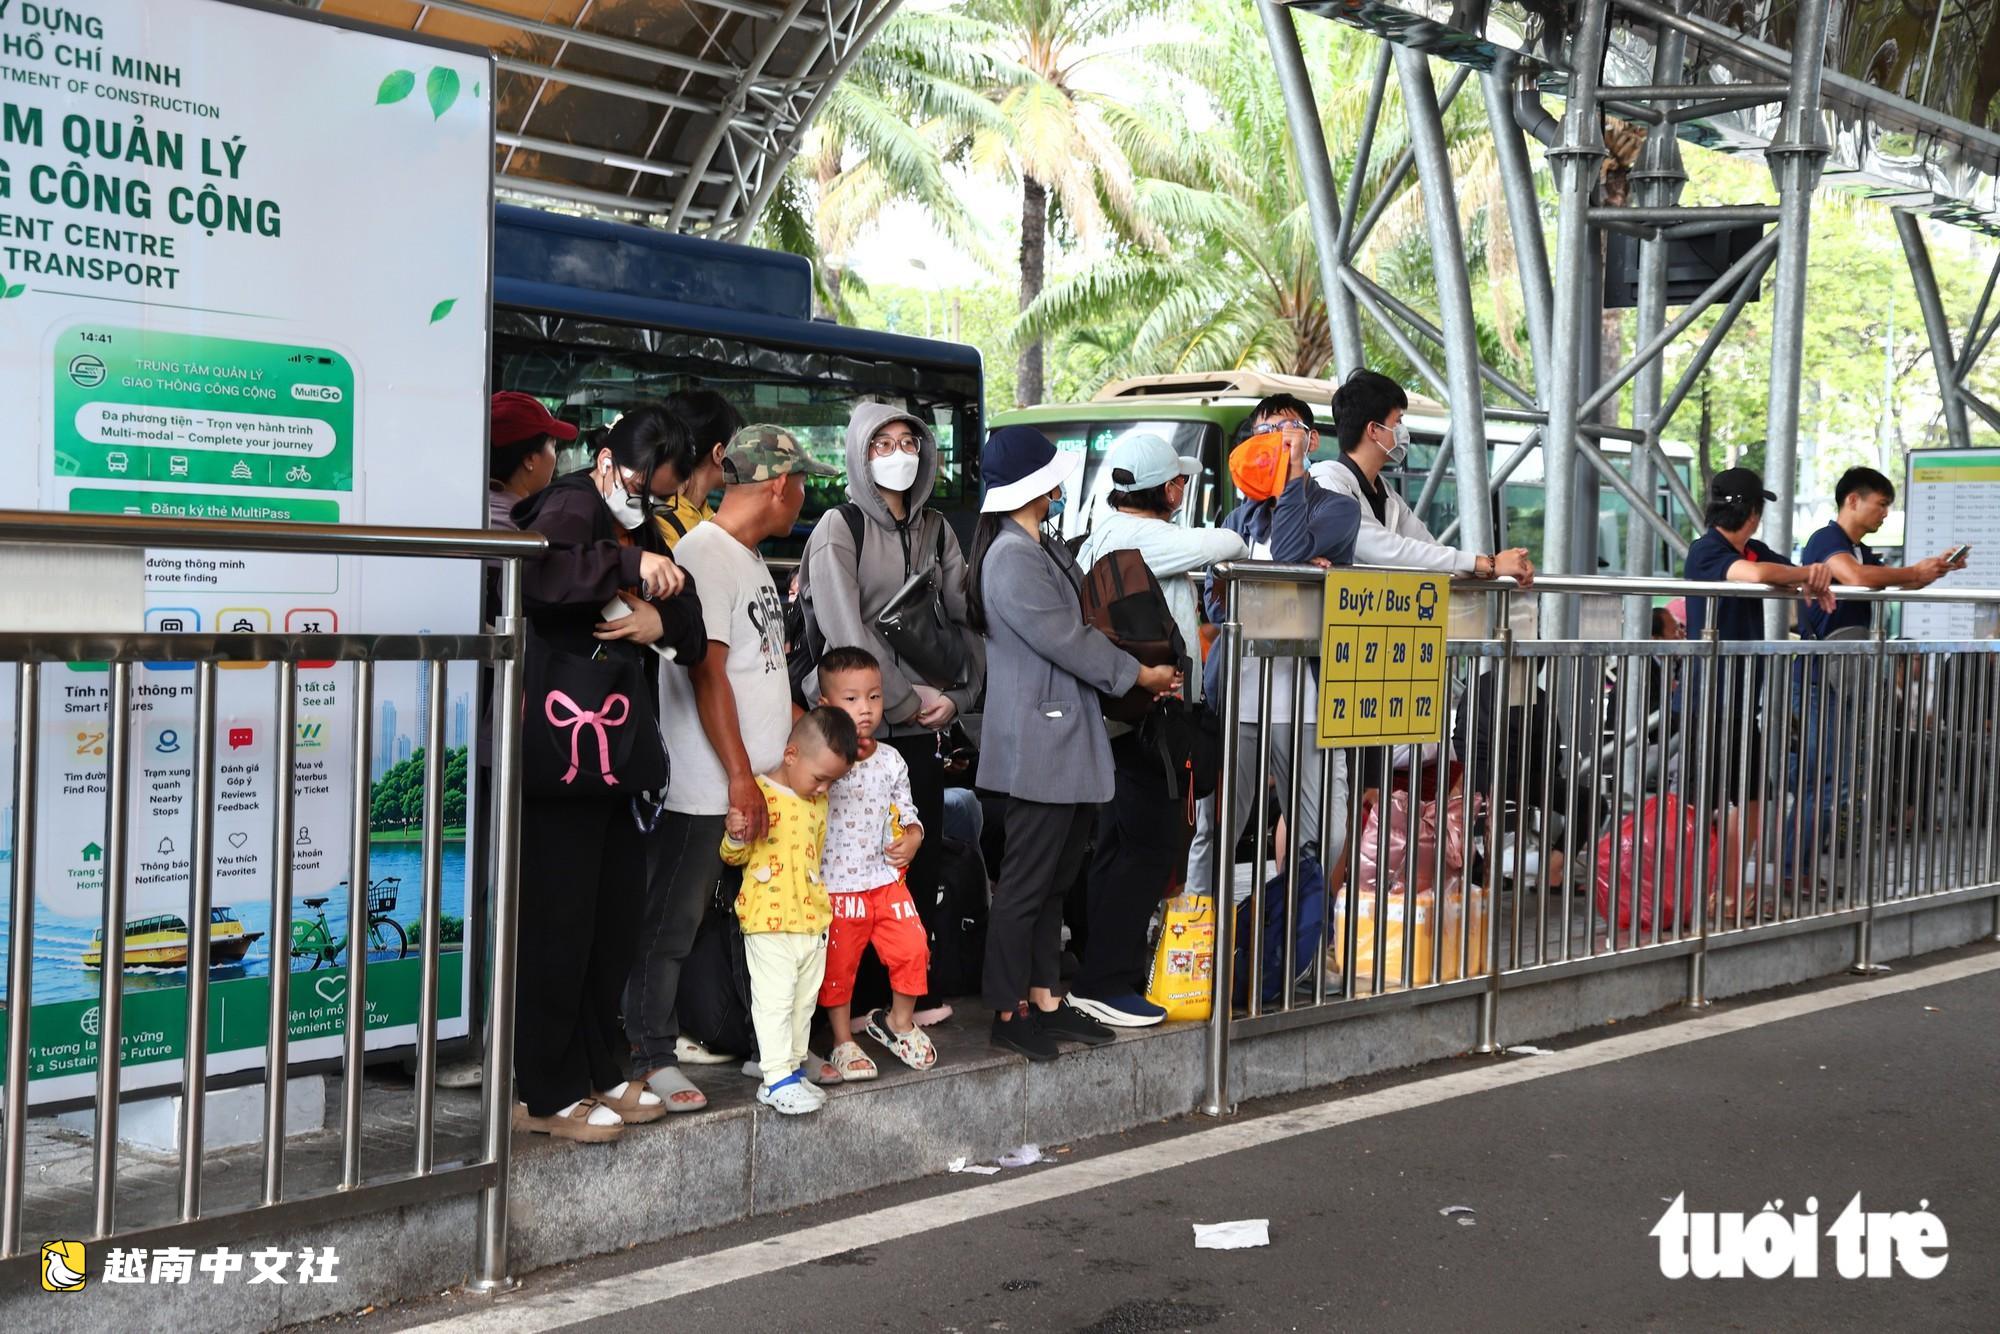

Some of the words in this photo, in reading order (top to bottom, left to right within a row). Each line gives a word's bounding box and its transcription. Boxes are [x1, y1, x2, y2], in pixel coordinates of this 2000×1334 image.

[22, 2, 103, 40] DỰNG
[3, 31, 44, 61] HỒ
[55, 45, 103, 72] CHÍ
[112, 55, 181, 88] MINH
[67, 79, 89, 94] OF
[95, 84, 220, 119] CONSTRUCTION
[62, 114, 183, 170] QUẢN
[201, 135, 247, 180] LÝ
[30, 161, 151, 219] CÔNG
[168, 182, 281, 238] CỘNG
[64, 223, 175, 259] CENTRE
[3, 247, 180, 289] TRANSPORT
[80, 332, 112, 343] 14:41
[135, 359, 179, 373] TRUNG
[250, 369, 263, 380] LÝ
[121, 376, 153, 389] GIAO
[157, 378, 201, 393] THÔNG
[204, 382, 240, 396] CÔNG
[242, 386, 277, 400] CỘNG
[102, 410, 118, 420] Đa
[121, 412, 167, 426] phương
[171, 416, 193, 428] tiện
[206, 418, 232, 430] Trọn
[235, 423, 255, 433] vẹn
[258, 422, 285, 433] hành
[288, 424, 313, 435] trình
[101, 426, 174, 441] Multi-modal
[188, 433, 243, 446] Complete
[246, 438, 270, 448] your
[272, 438, 313, 452] journey
[151, 503, 185, 516] Đăng
[189, 504, 204, 517] ký
[231, 506, 290, 519] MultiPass
[146, 558, 182, 570] đường
[185, 558, 216, 570] thông
[219, 560, 246, 569] minh
[155, 574, 181, 582] route
[184, 574, 218, 584] finding
[1339, 587, 1374, 617] Buýt
[1385, 589, 1411, 612] Bus
[1335, 642, 1350, 664] 04
[1365, 642, 1379, 664] 27
[1392, 642, 1406, 664] 28
[1419, 642, 1433, 664] 39
[64, 686, 96, 698] Tính
[138, 684, 177, 698] thông
[304, 682, 319, 692] tất
[322, 681, 336, 692] cả
[64, 702, 101, 713] Smart
[303, 697, 321, 706] See
[323, 697, 335, 706] all
[1359, 697, 1378, 719] 102
[1389, 697, 1404, 718] 171
[1415, 696, 1432, 717] 172
[1332, 698, 1346, 720] 72
[220, 764, 244, 774] Đánh
[245, 764, 260, 774] giá
[313, 761, 324, 769] vé
[143, 769, 167, 779] Trạm
[168, 768, 191, 778] xung
[294, 773, 328, 781] aterbus
[152, 781, 181, 791] quanh
[226, 777, 245, 786] Góp
[63, 785, 85, 795] Find
[221, 790, 257, 800] Reviews
[304, 785, 329, 794] Ticket
[149, 795, 183, 804] Nearby
[152, 806, 180, 816] Stops
[217, 802, 260, 812] Feedback
[235, 854, 258, 863] thích
[67, 868, 95, 878] Trang
[140, 862, 170, 872] Thông
[172, 860, 189, 869] báo
[216, 867, 257, 877] Favorites
[135, 874, 189, 885] Notification
[288, 1009, 306, 1021] iện
[309, 1007, 323, 1019] lợi
[368, 1013, 389, 1024] Day
[41, 1042, 81, 1056] tương
[36, 1065, 45, 1073] a
[131, 1045, 172, 1059] Future
